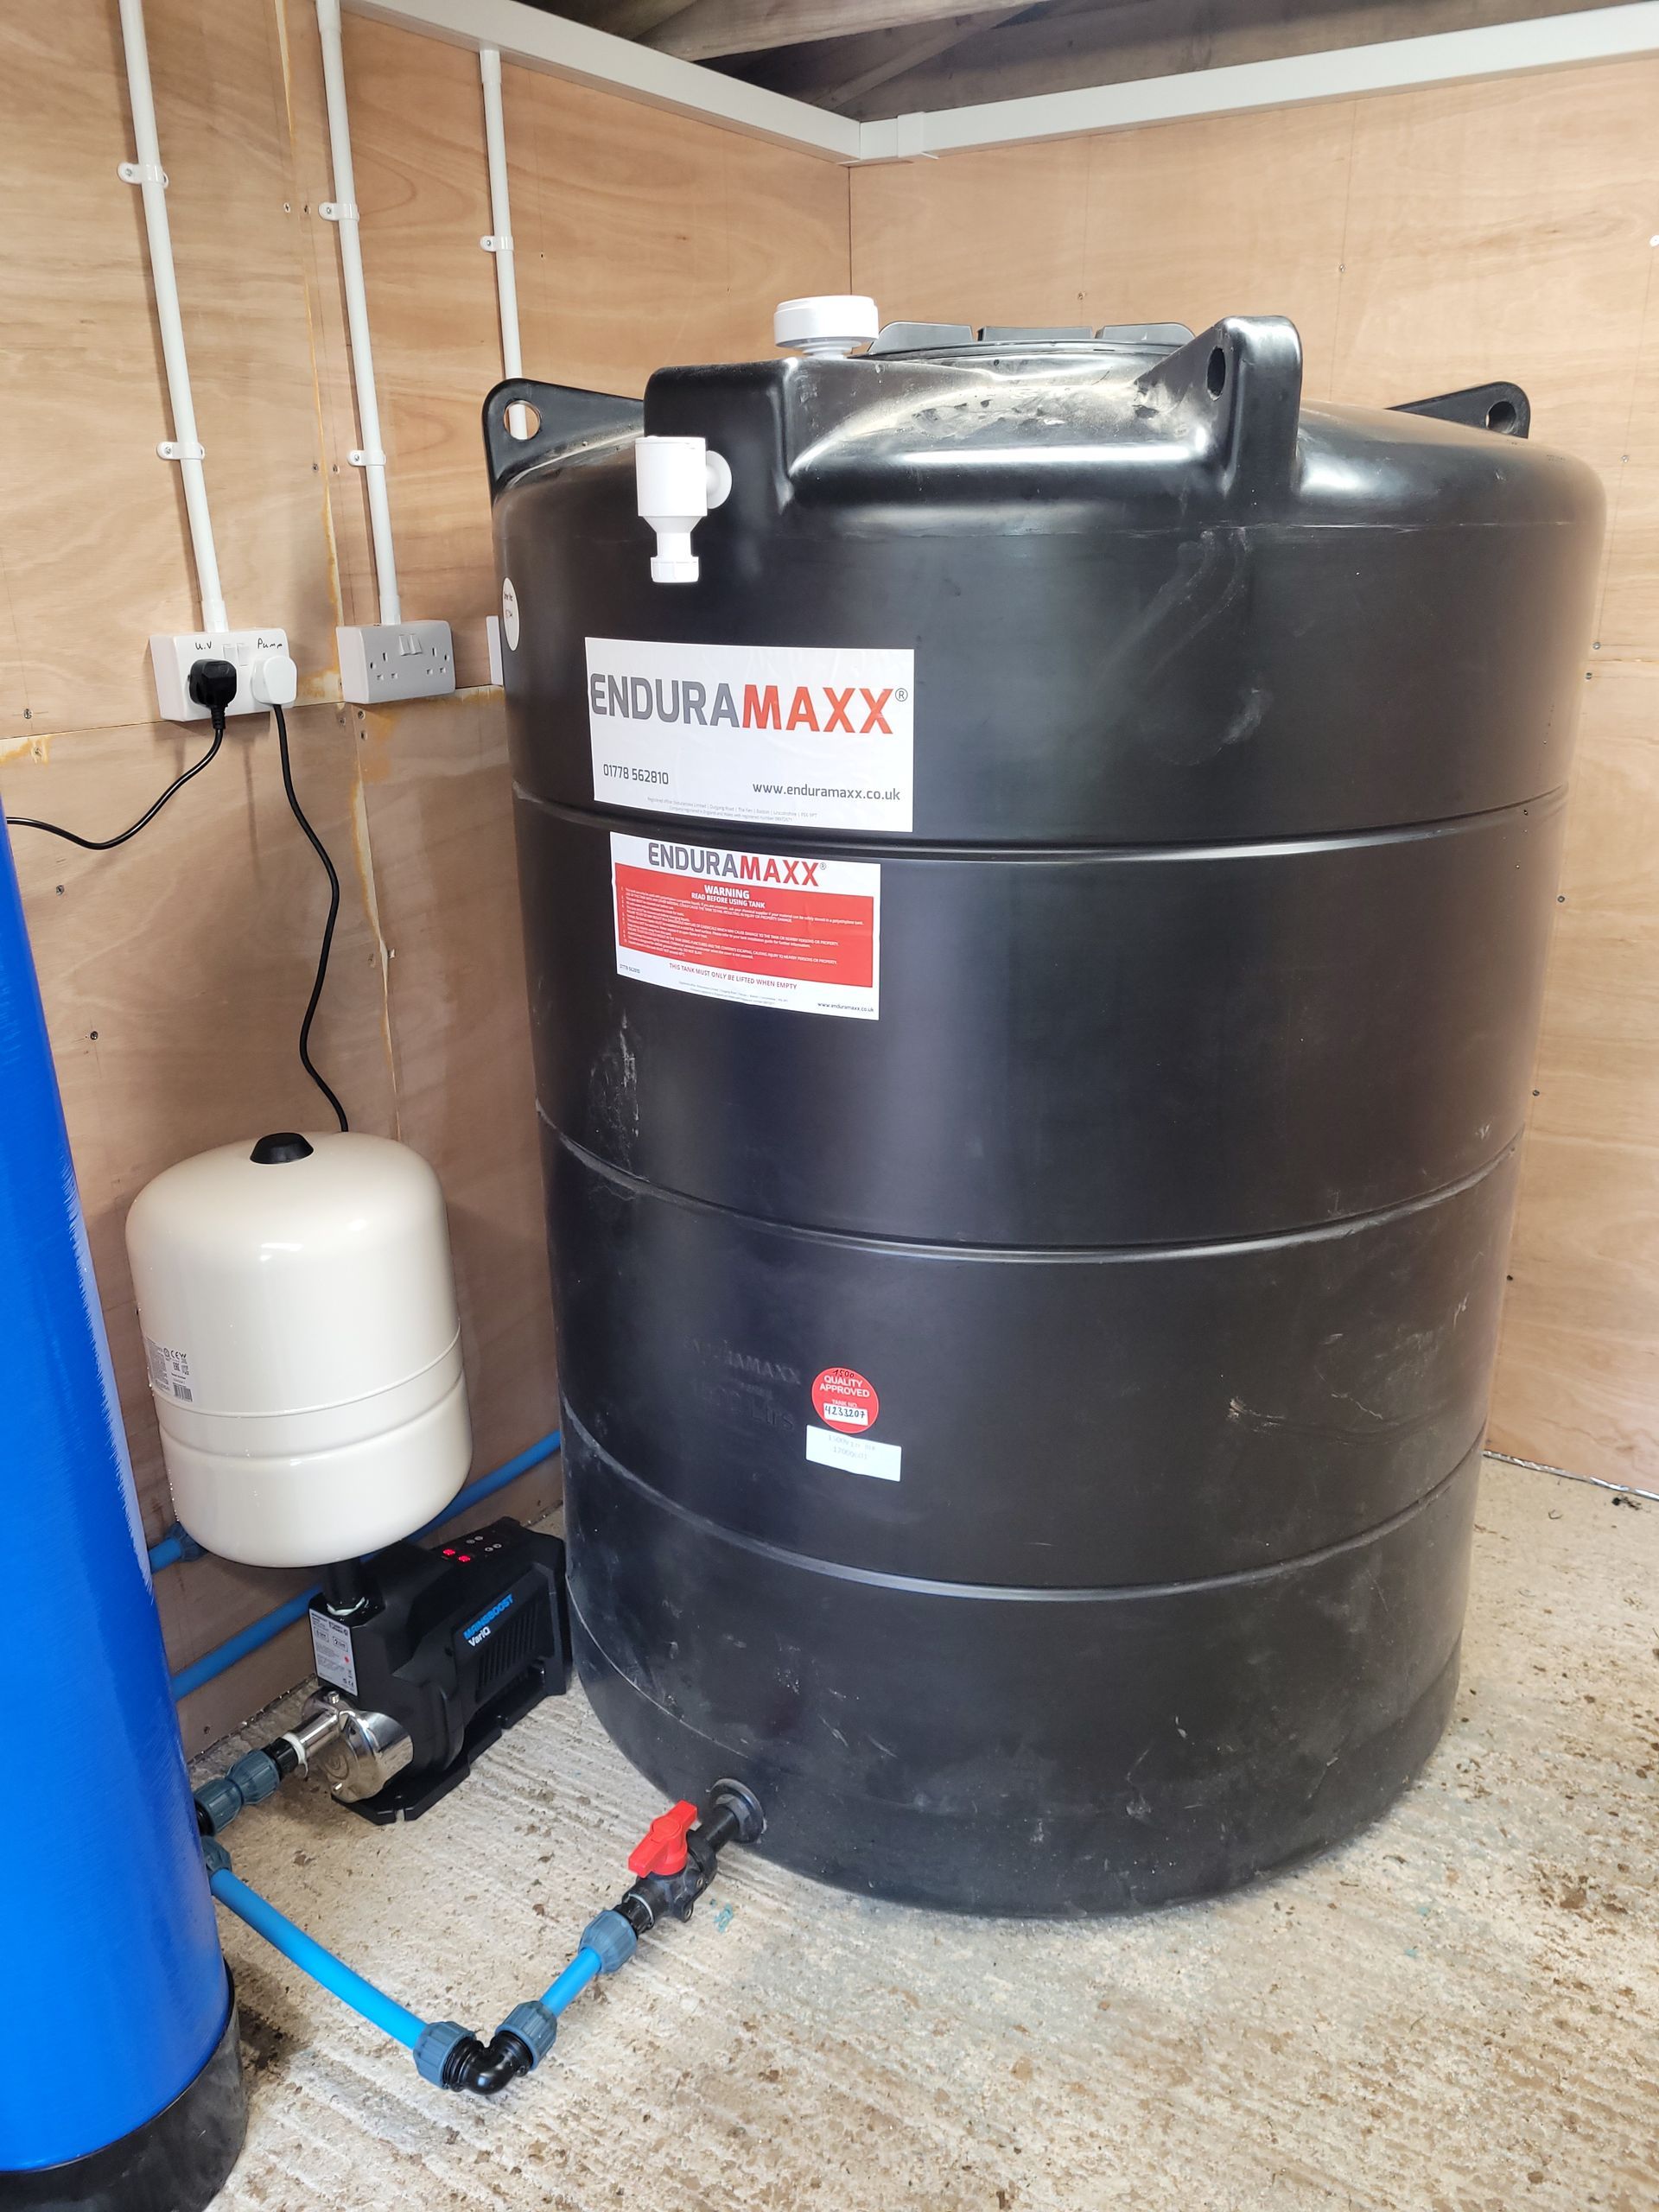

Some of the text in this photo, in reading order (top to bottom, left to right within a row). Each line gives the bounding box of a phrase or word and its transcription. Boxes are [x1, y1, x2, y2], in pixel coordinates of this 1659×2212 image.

[257, 638, 283, 649] Pump
[603, 763, 669, 785] 01778 562810
[753, 783, 900, 801] www.enduramaxx.co.uk
[704, 884, 750, 899] WARNING
[707, 895, 728, 904] BEFORE
[681, 965, 696, 974] TANK
[696, 968, 710, 976] MUST
[711, 971, 727, 980] ONLY
[736, 976, 754, 984] LIFTED
[756, 978, 775, 987] WHEN
[823, 1375, 862, 1388] QUALITY
[819, 1383, 870, 1397] APPROVED
[468, 1626, 491, 1647] VariQ
